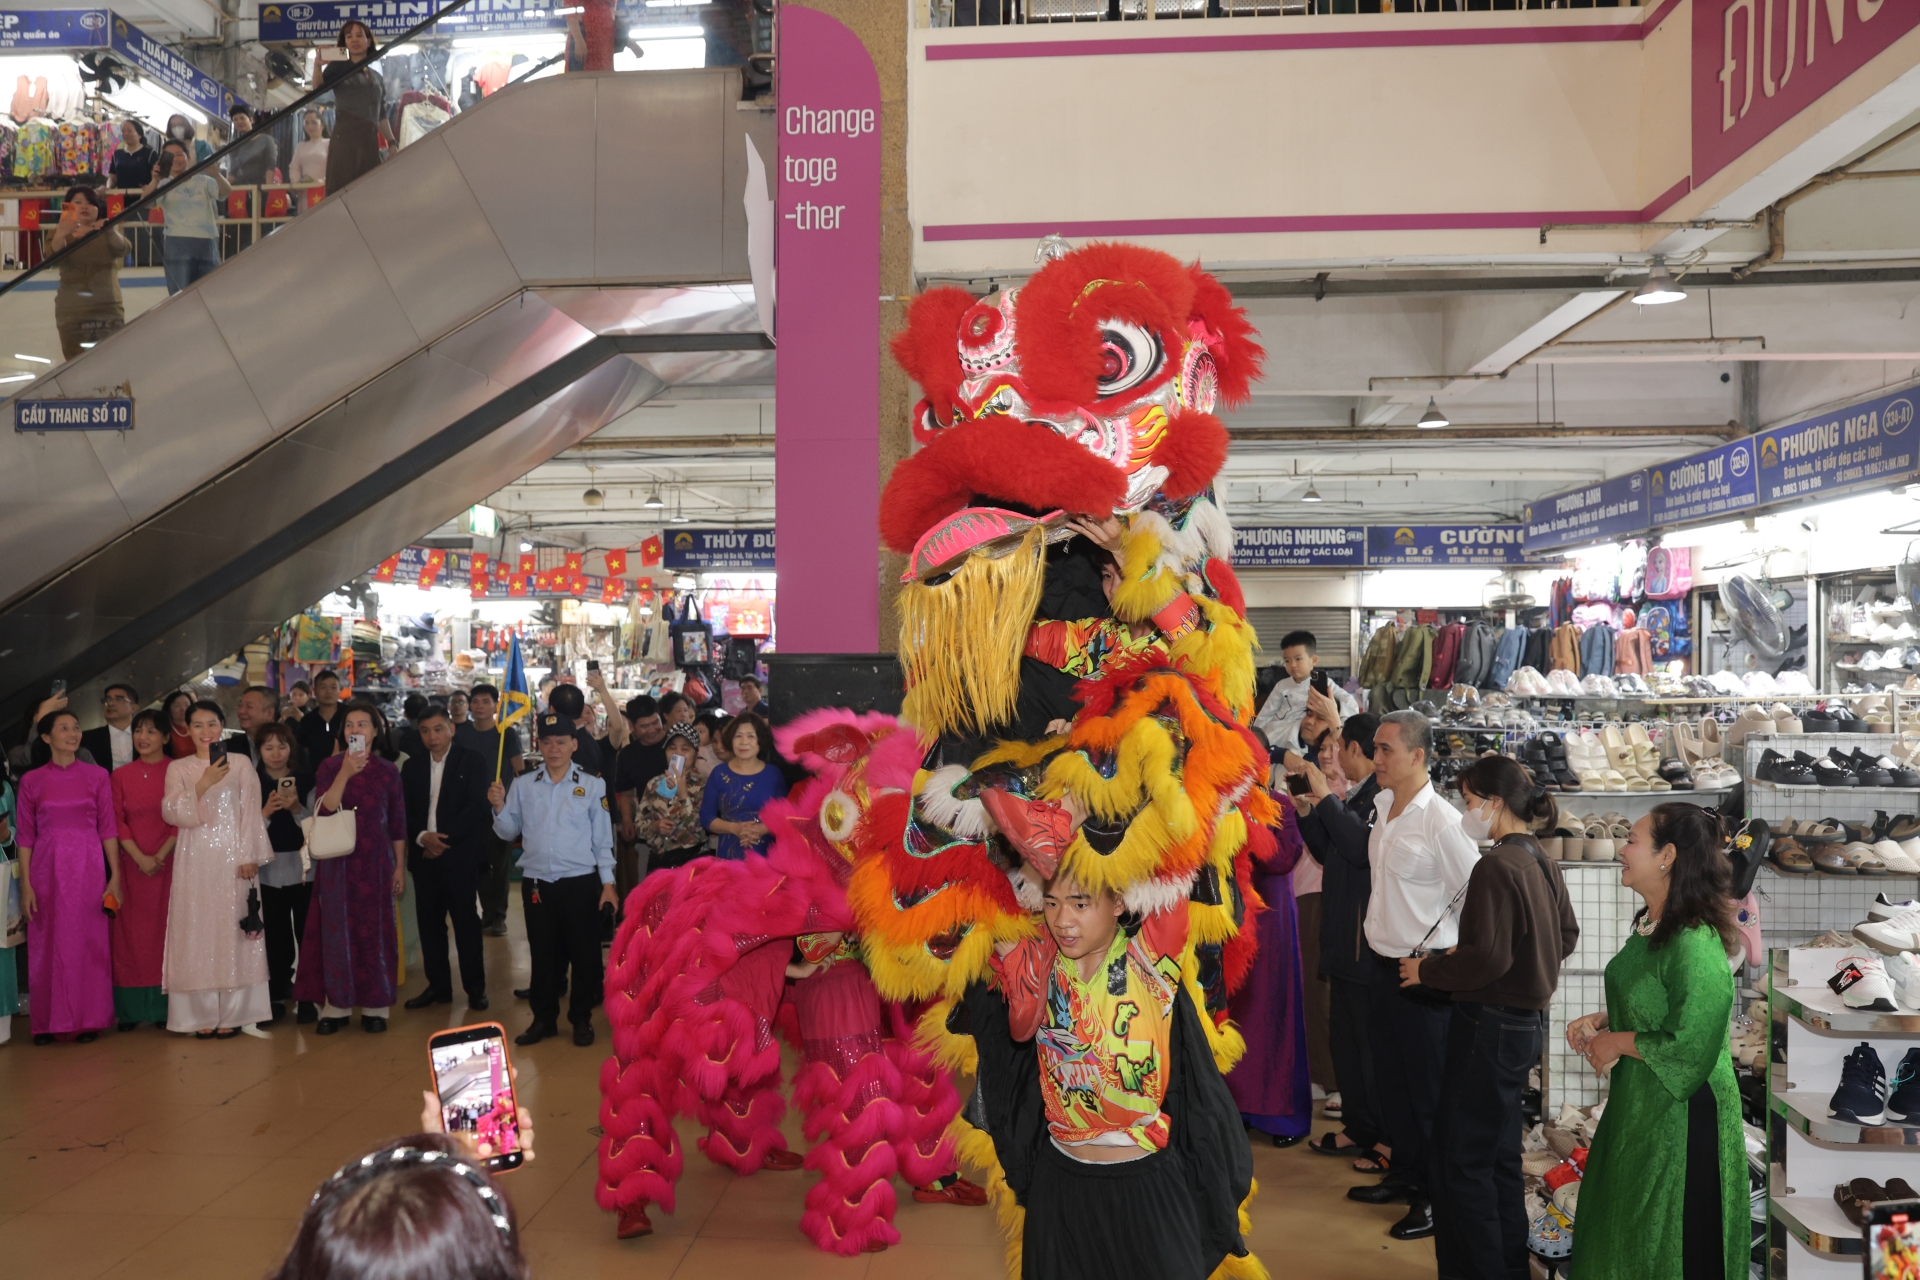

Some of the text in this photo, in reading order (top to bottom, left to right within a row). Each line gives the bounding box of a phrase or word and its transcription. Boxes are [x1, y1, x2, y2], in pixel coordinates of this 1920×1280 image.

[334, 1, 429, 17] THÌN
[296, 19, 329, 31] CHUYÊN
[377, 16, 394, 28] BÁN
[495, 11, 515, 22] NAM
[141, 36, 169, 67] TUẤN
[171, 56, 194, 81] ĐIỆP
[785, 105, 875, 138] Change
[784, 155, 837, 187] toge
[784, 200, 846, 230] -ther
[21, 402, 127, 424] CẦU THANG SỐ 10
[1780, 411, 1879, 462] PHƯƠNG NGA
[1669, 454, 1725, 491] CƯỜNG DỰ
[1586, 487, 1602, 506] ANH
[702, 530, 749, 549] THỦY
[1233, 528, 1293, 546] PHƯƠNG
[1295, 528, 1347, 546] NHUNG
[1255, 547, 1265, 557] LẺ
[1293, 546, 1311, 557] DÉP
[1313, 547, 1331, 556] CÁC
[1333, 548, 1354, 558] LOẠI
